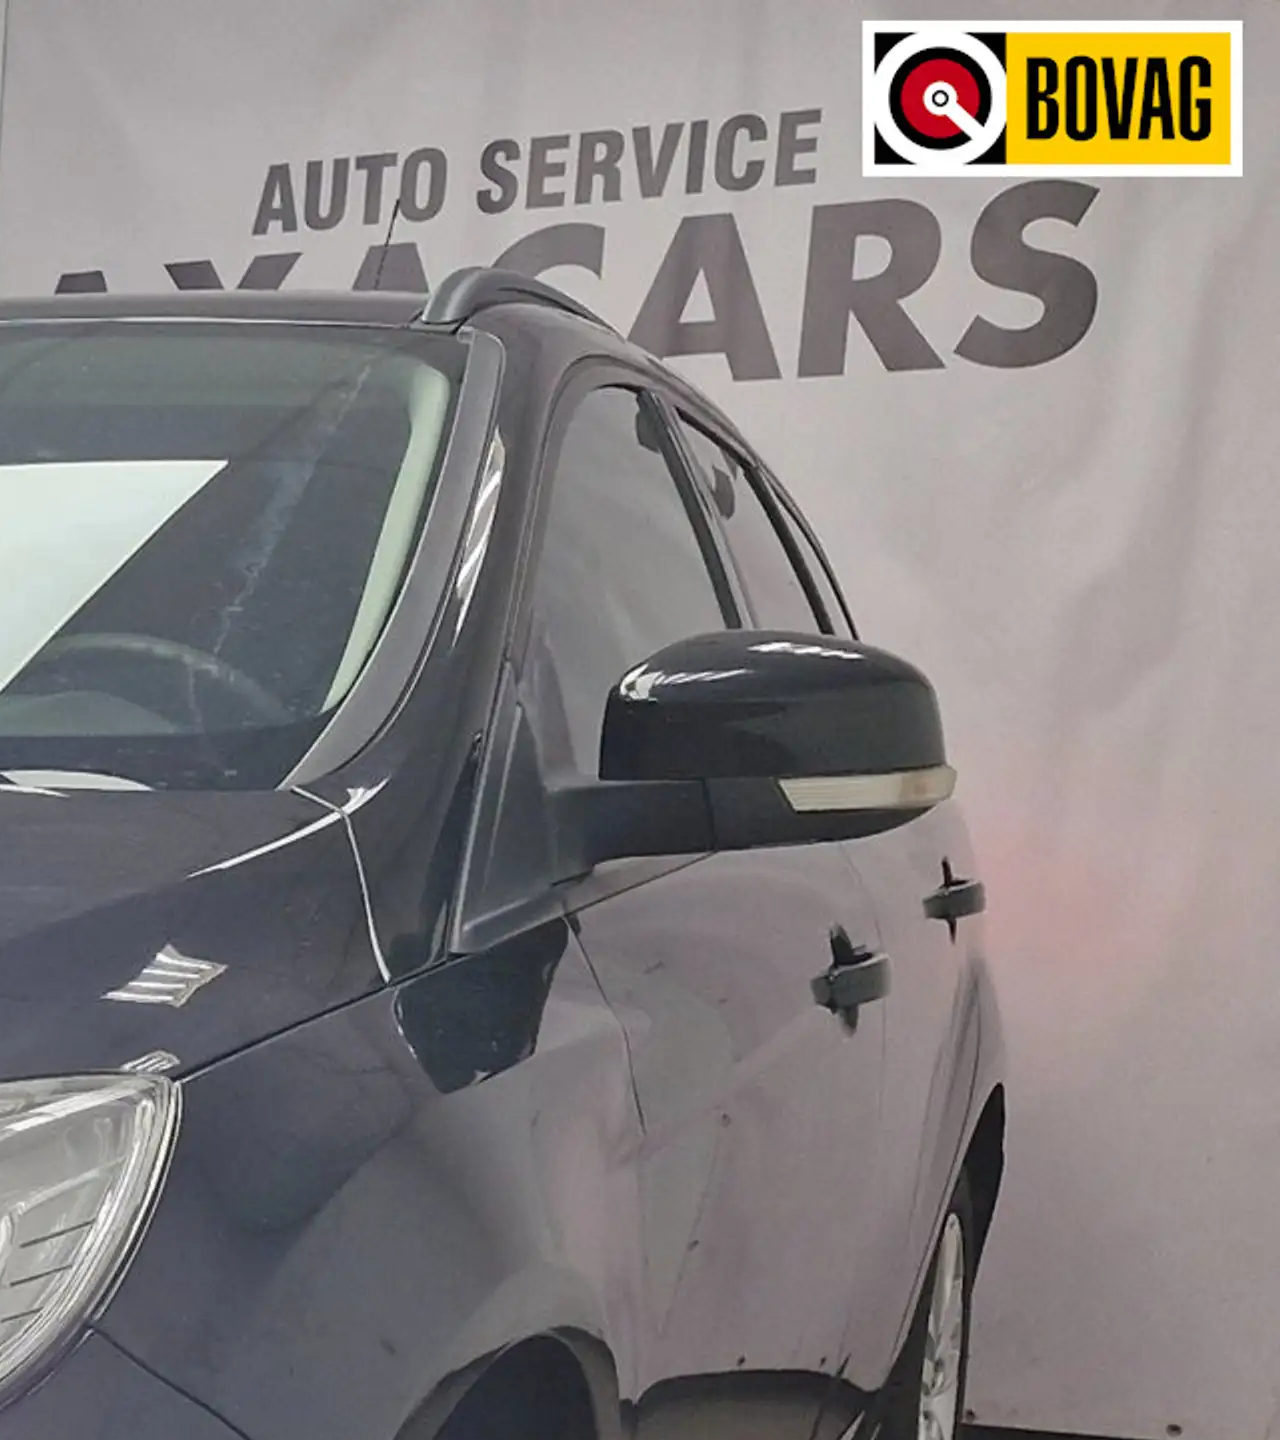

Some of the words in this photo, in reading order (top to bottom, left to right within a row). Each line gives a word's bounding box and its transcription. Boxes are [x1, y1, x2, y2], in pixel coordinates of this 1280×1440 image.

[251, 147, 448, 236] AUTO
[476, 108, 823, 216] SERVICE
[53, 178, 1100, 382] CARS
